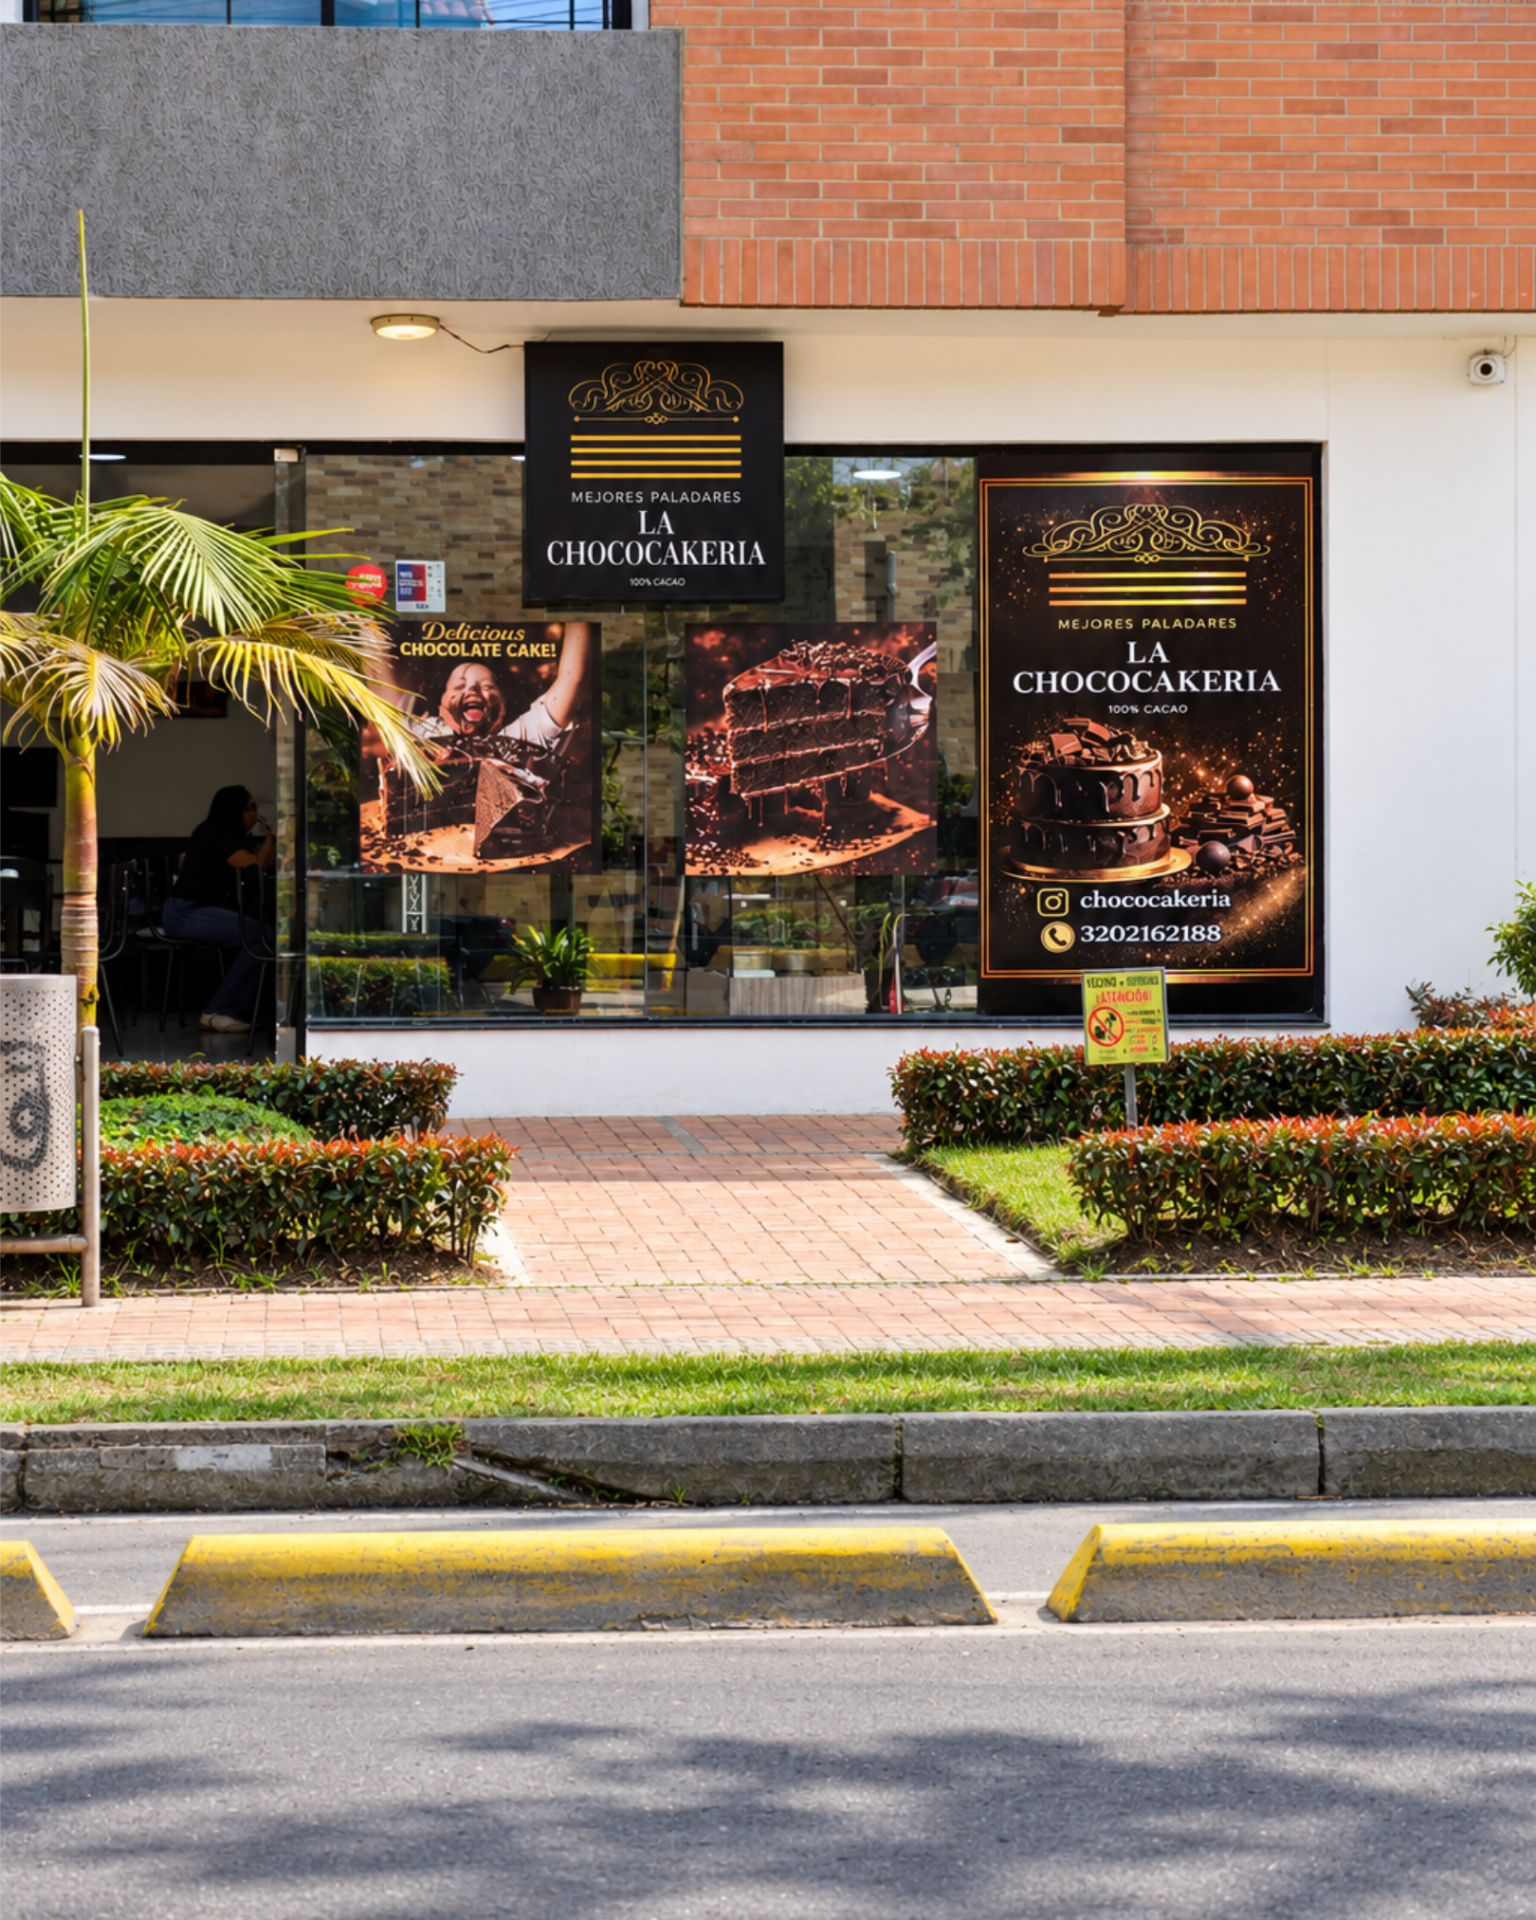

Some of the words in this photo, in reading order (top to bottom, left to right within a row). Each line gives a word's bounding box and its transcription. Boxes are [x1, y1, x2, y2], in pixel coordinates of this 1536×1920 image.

[571, 491, 644, 503] MEJORES
[651, 491, 741, 503] PALADARES
[638, 510, 675, 535] LA
[546, 540, 766, 566] CHOCOCAKERIA
[629, 577, 652, 587] 100%
[653, 577, 686, 587] CACAO
[421, 621, 526, 642] Delicious
[1058, 618, 1134, 630] MEJORES
[1142, 617, 1237, 629] PALADARES
[400, 642, 502, 657] CHOCOLATE
[506, 643, 557, 657] CAKE!
[1127, 641, 1170, 664] LA
[1012, 669, 1282, 694] CHOCOCAKERIA
[1108, 704, 1139, 714] 100%
[1143, 704, 1188, 714] CACAO
[1080, 889, 1231, 909] chococakeria
[1080, 925, 1222, 943] 3202162188
